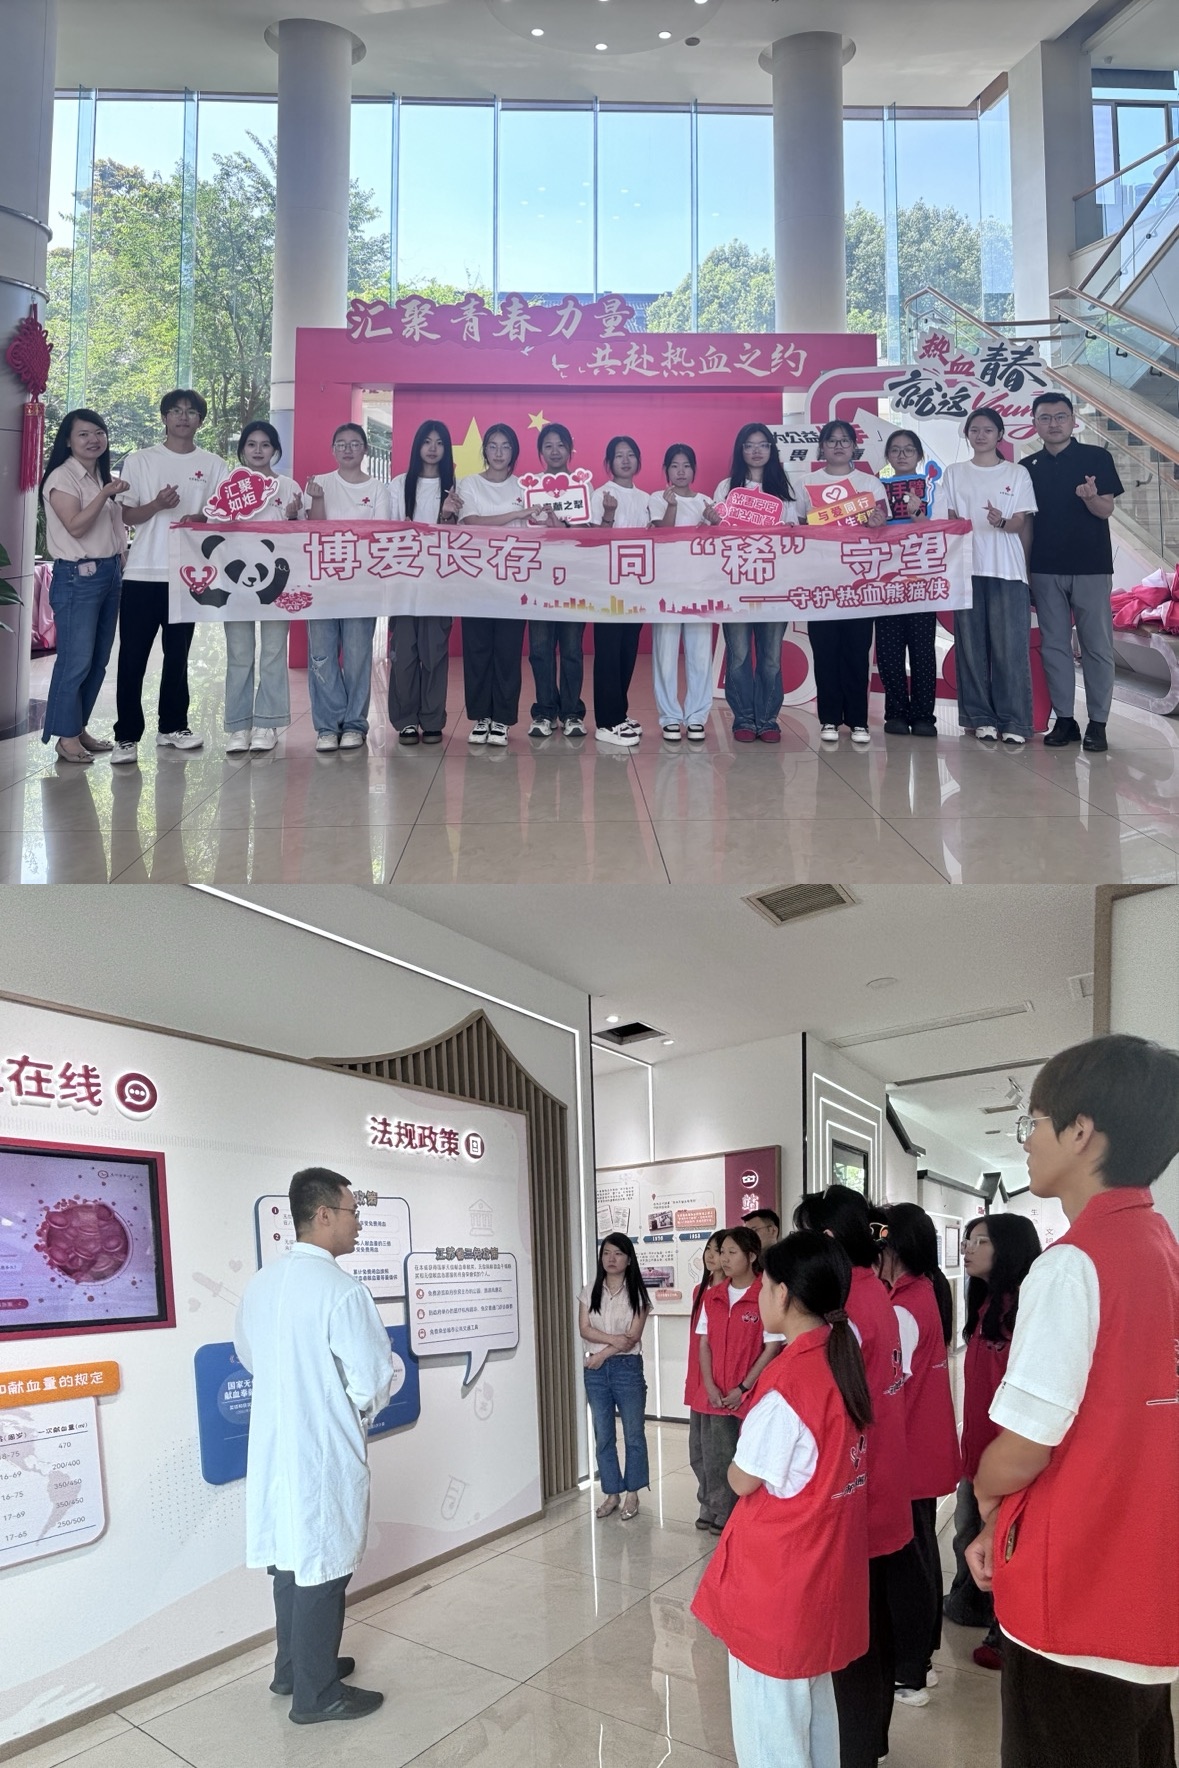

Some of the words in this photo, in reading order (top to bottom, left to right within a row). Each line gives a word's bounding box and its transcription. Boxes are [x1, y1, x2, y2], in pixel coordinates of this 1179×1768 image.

[350, 296, 632, 342] 汇聚青春力量
[587, 341, 807, 378] 共赴热血之约
[888, 370, 973, 417] 就这
[224, 477, 254, 499] 汇聚
[228, 491, 258, 513] 如炬
[817, 496, 870, 522] 与爱同行
[0, 1054, 104, 1107] 在线
[369, 1116, 461, 1157] 法规政策
[227, 1379, 252, 1391] 国家无
[58, 1441, 72, 1450] 470
[52, 1459, 81, 1471] 200/400
[1, 1490, 25, 1502] 16-75
[53, 1478, 83, 1491] 350/450
[3, 1510, 26, 1522] 17-69
[55, 1497, 85, 1510] 350/450
[5, 1530, 28, 1542] 17-65
[57, 1515, 87, 1529] 250/500
